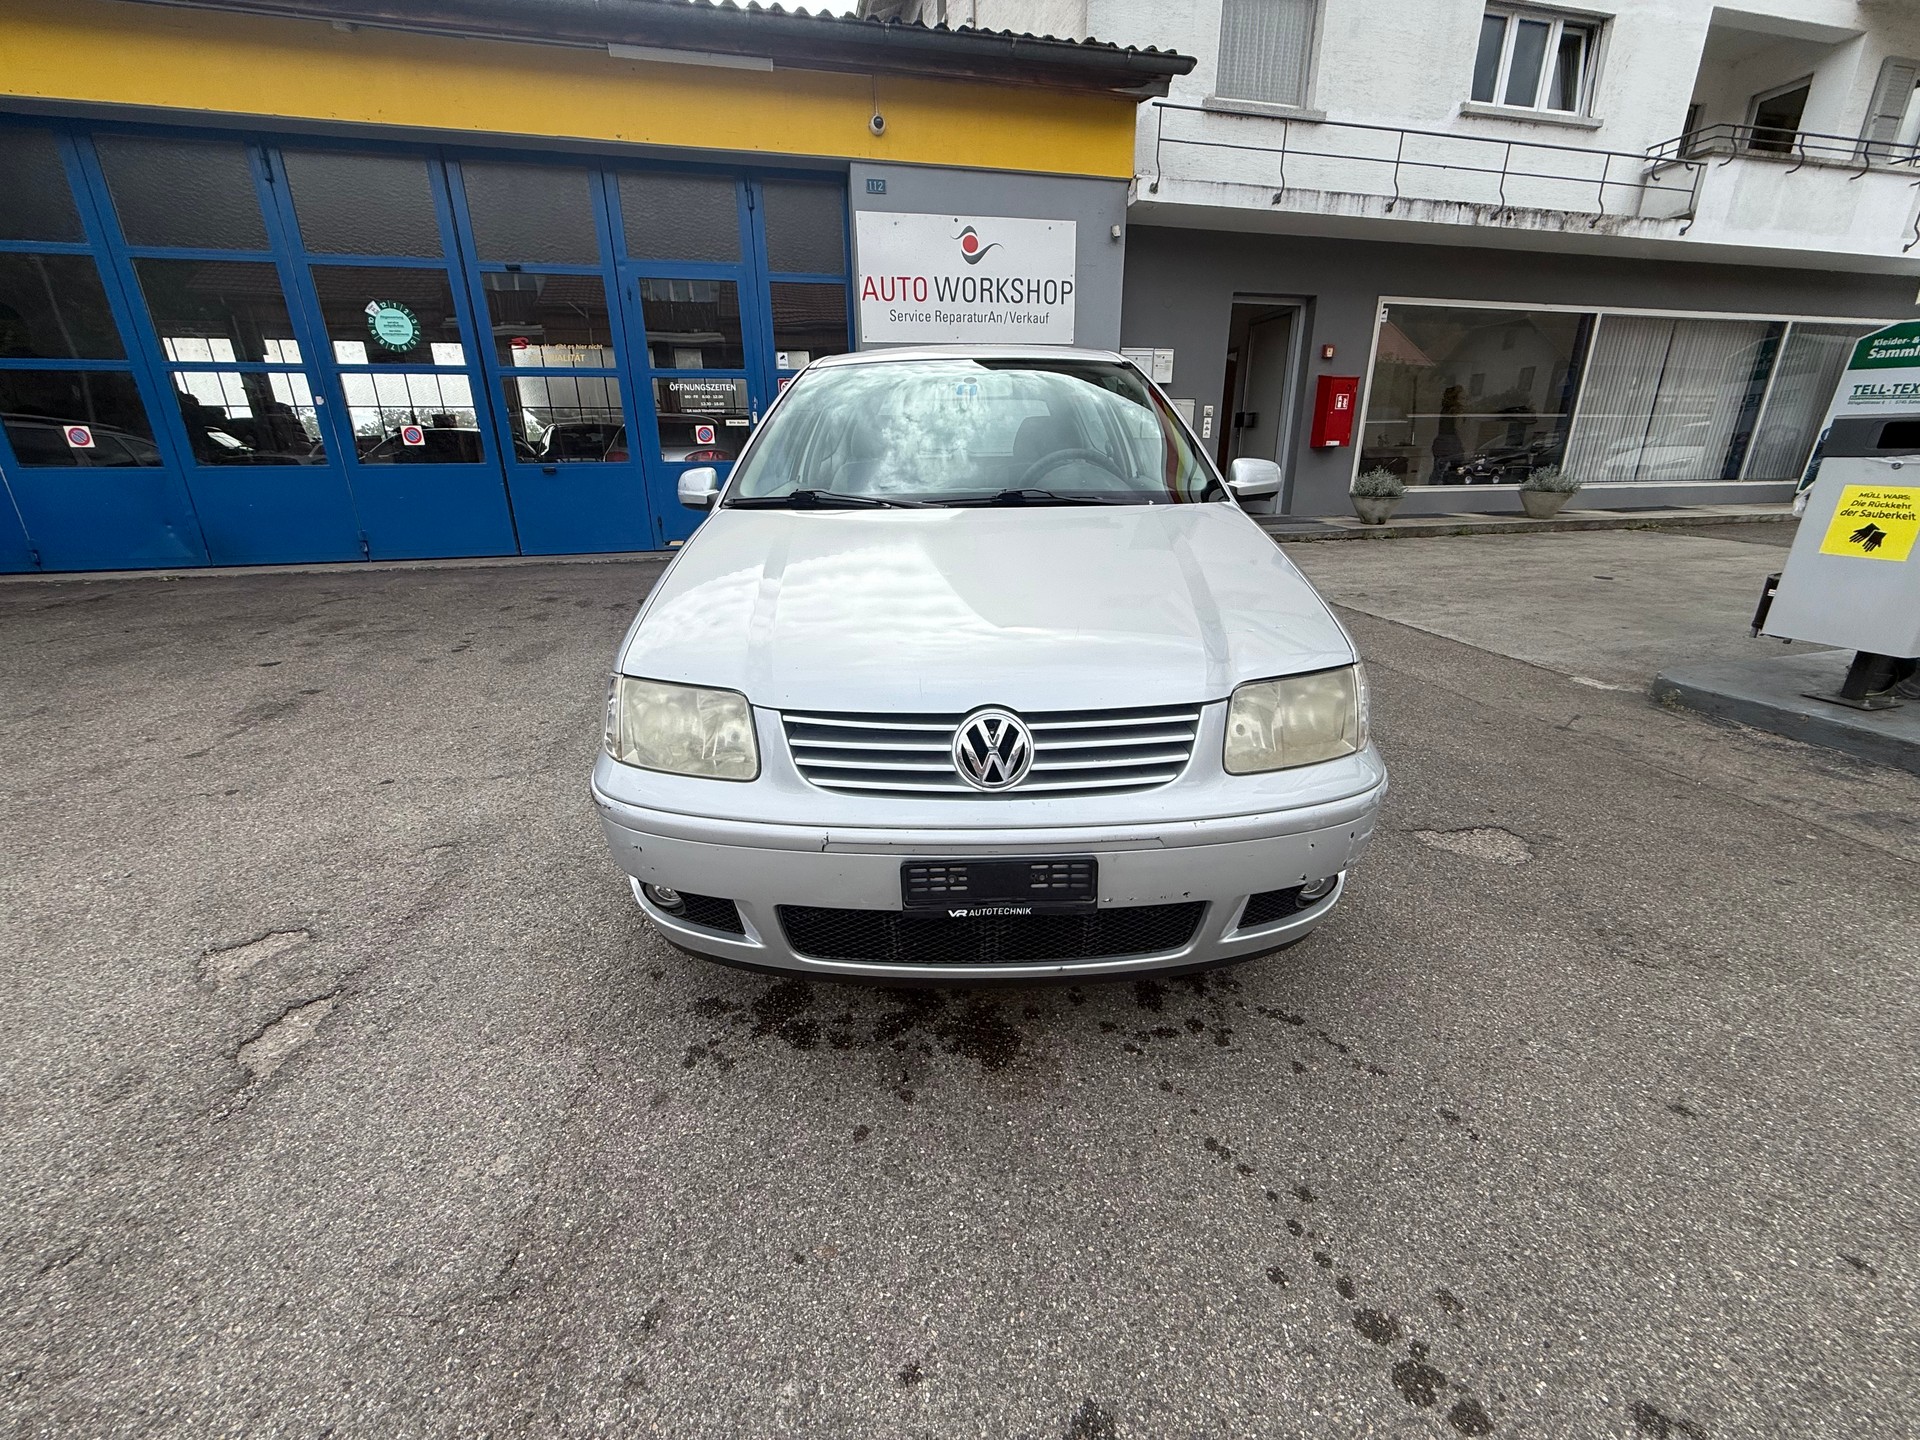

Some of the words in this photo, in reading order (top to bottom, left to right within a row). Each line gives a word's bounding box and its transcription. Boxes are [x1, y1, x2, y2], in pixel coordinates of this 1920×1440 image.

[868, 181, 884, 191] 112
[862, 276, 928, 302] AUTO
[934, 276, 1074, 305] WORKSHOP
[889, 309, 932, 323] Service
[935, 310, 1050, 325] ReparaturAn/Verkauf
[1873, 337, 1911, 346] Kleider-
[669, 382, 737, 391] ÖFFNUNGSZEITEN
[1853, 383, 1920, 395] TELL-TEX
[1867, 501, 1912, 510] Rückkehr
[1840, 508, 1859, 517] der
[1859, 509, 1917, 521] Sauberkeit
[956, 713, 1031, 788] VW
[948, 909, 968, 918] VR
[968, 907, 1032, 917] AUTOTECHNIK
